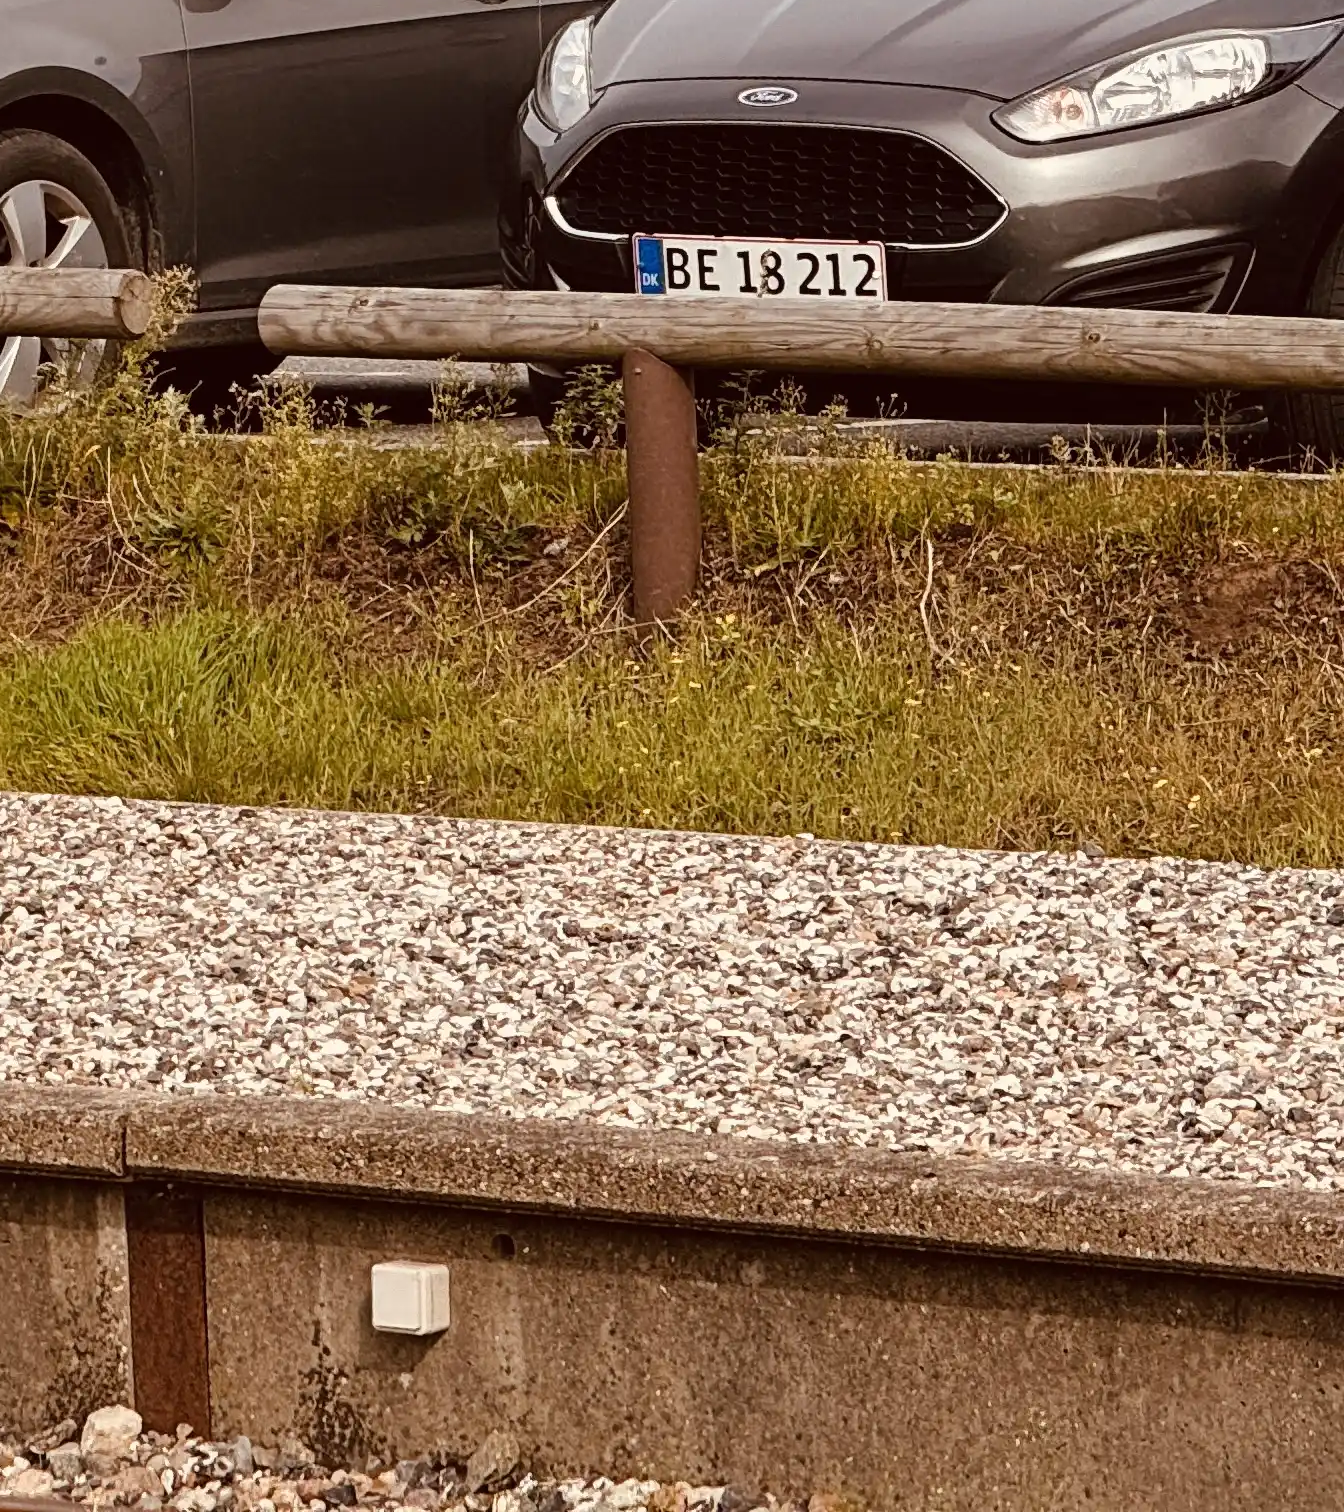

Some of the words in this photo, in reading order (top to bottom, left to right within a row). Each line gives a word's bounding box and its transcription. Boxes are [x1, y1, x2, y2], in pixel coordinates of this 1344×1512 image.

[642, 273, 659, 287] DK
[666, 248, 720, 292] BE
[737, 249, 786, 296] 18
[796, 252, 879, 297] 212
